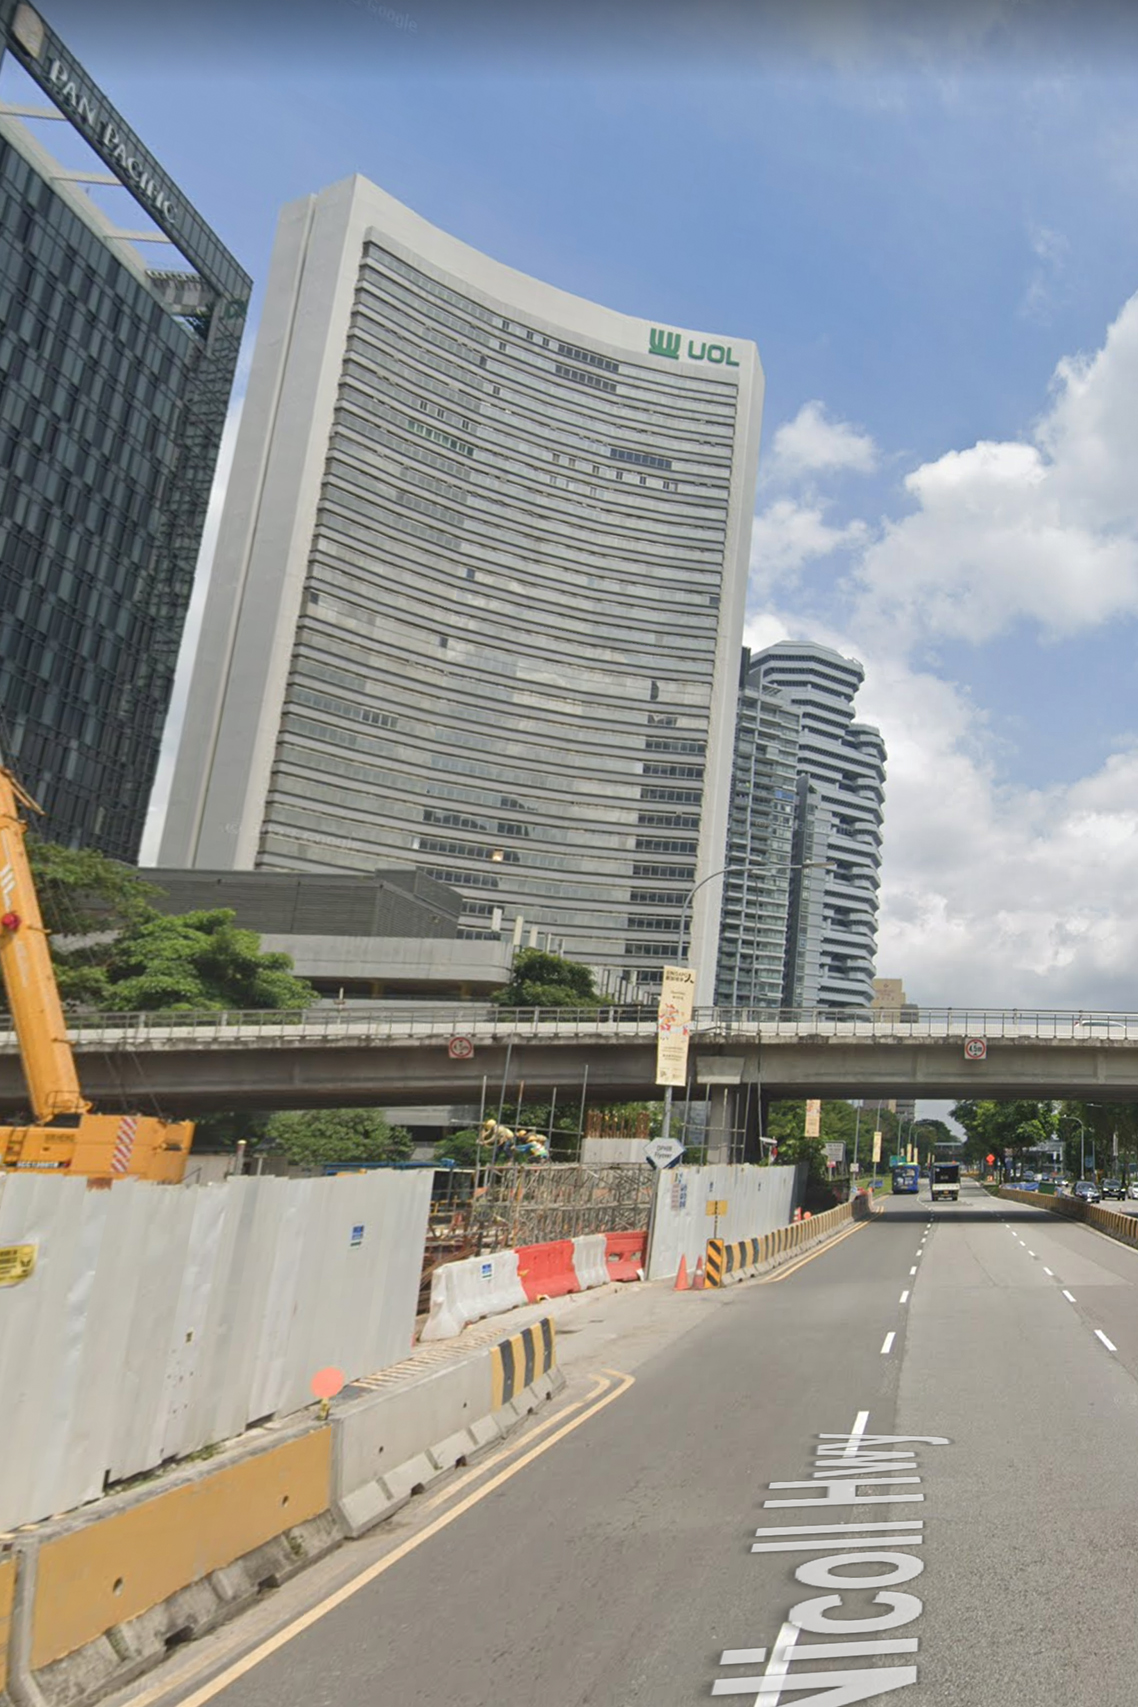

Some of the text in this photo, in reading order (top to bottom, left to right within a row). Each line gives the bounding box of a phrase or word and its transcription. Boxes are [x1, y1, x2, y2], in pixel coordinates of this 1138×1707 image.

[49, 59, 179, 224] PAN PACIFIC
[688, 340, 740, 367] UOL
